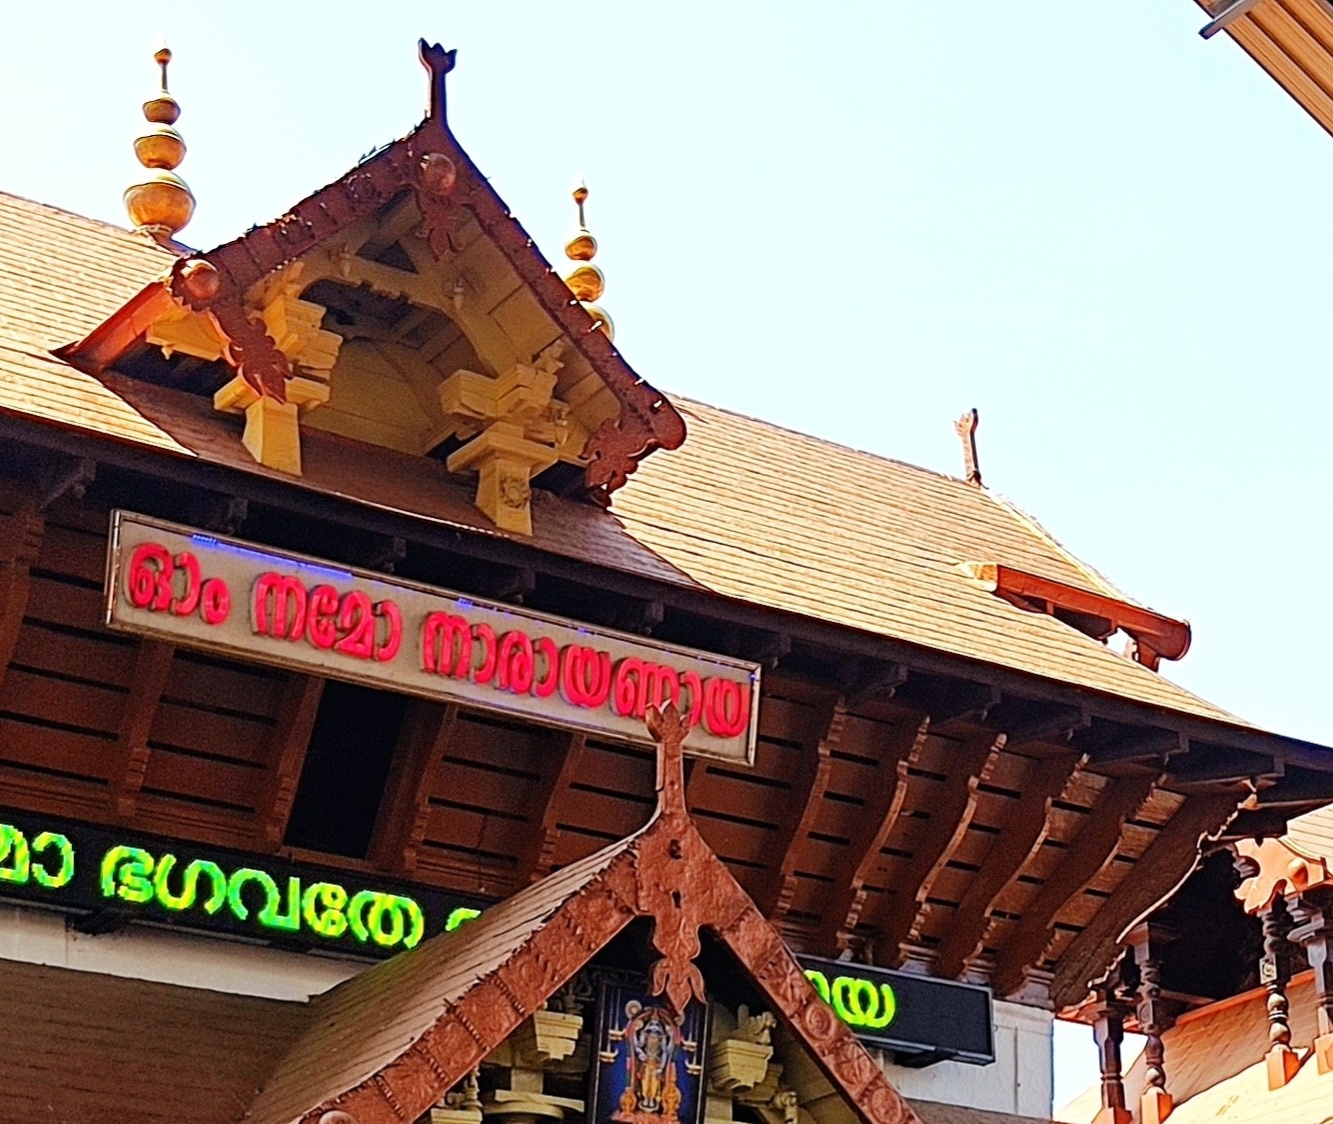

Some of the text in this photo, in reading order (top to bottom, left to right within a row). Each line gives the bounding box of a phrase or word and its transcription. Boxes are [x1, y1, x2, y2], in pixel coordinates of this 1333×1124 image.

[126, 541, 751, 739] ഓം നമോ നാരായണായ
[99, 845, 427, 949] ഭഗവതേ
